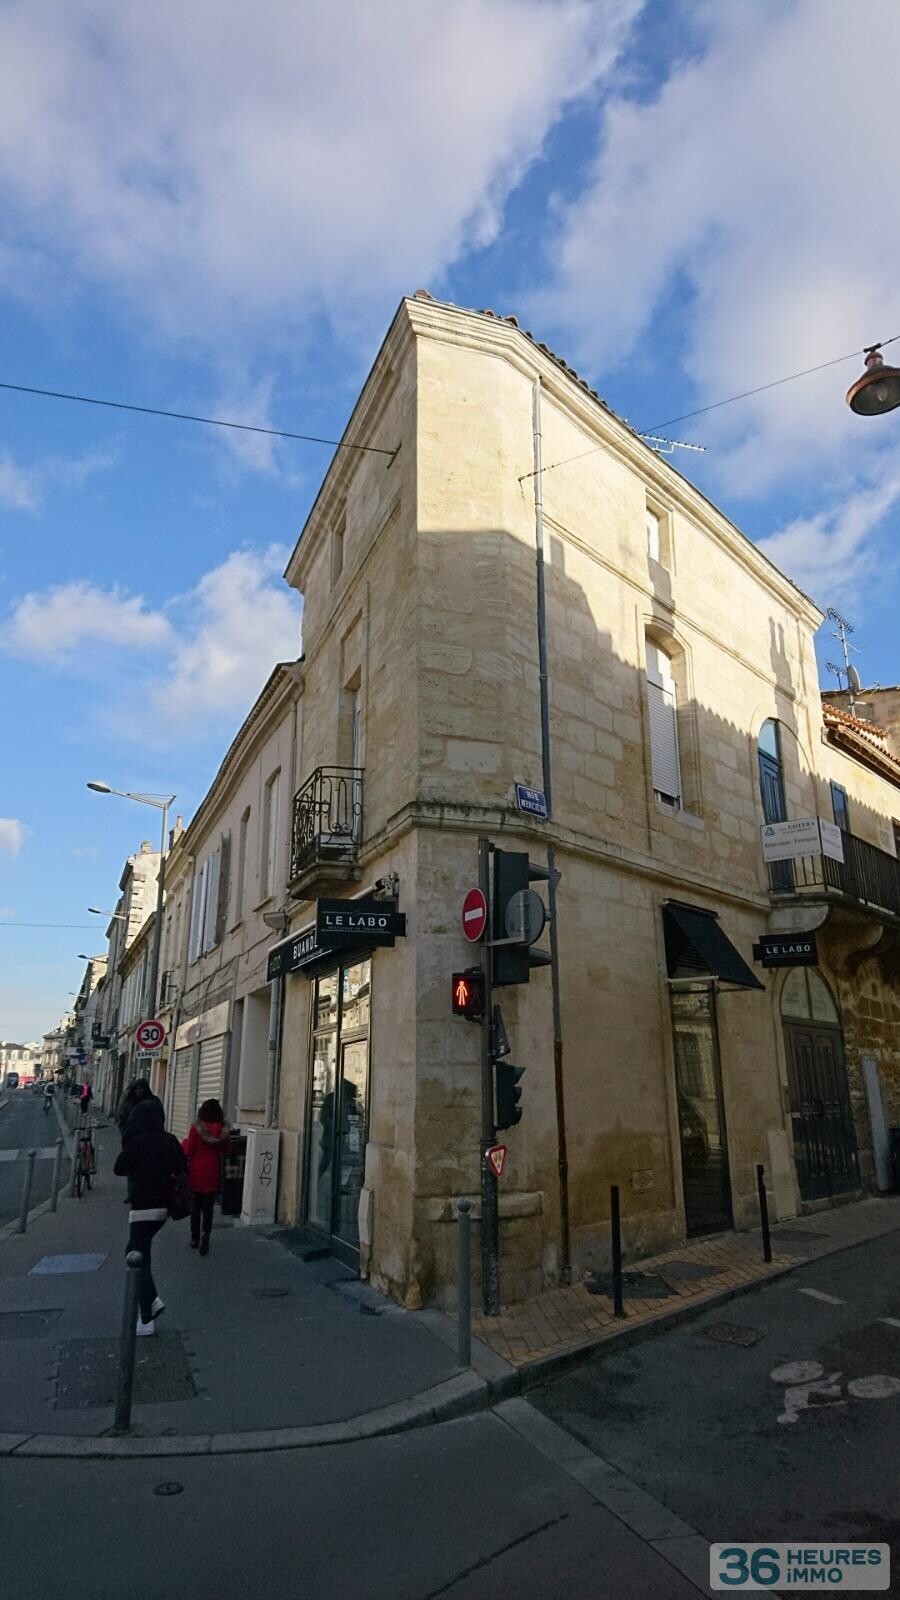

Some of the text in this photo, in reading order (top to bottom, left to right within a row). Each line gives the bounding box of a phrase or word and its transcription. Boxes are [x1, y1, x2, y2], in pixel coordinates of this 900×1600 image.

[326, 916, 387, 927] LE LABO
[293, 935, 318, 960] BUAND
[766, 944, 811, 954] LE LABO
[142, 1028, 159, 1041] 30
